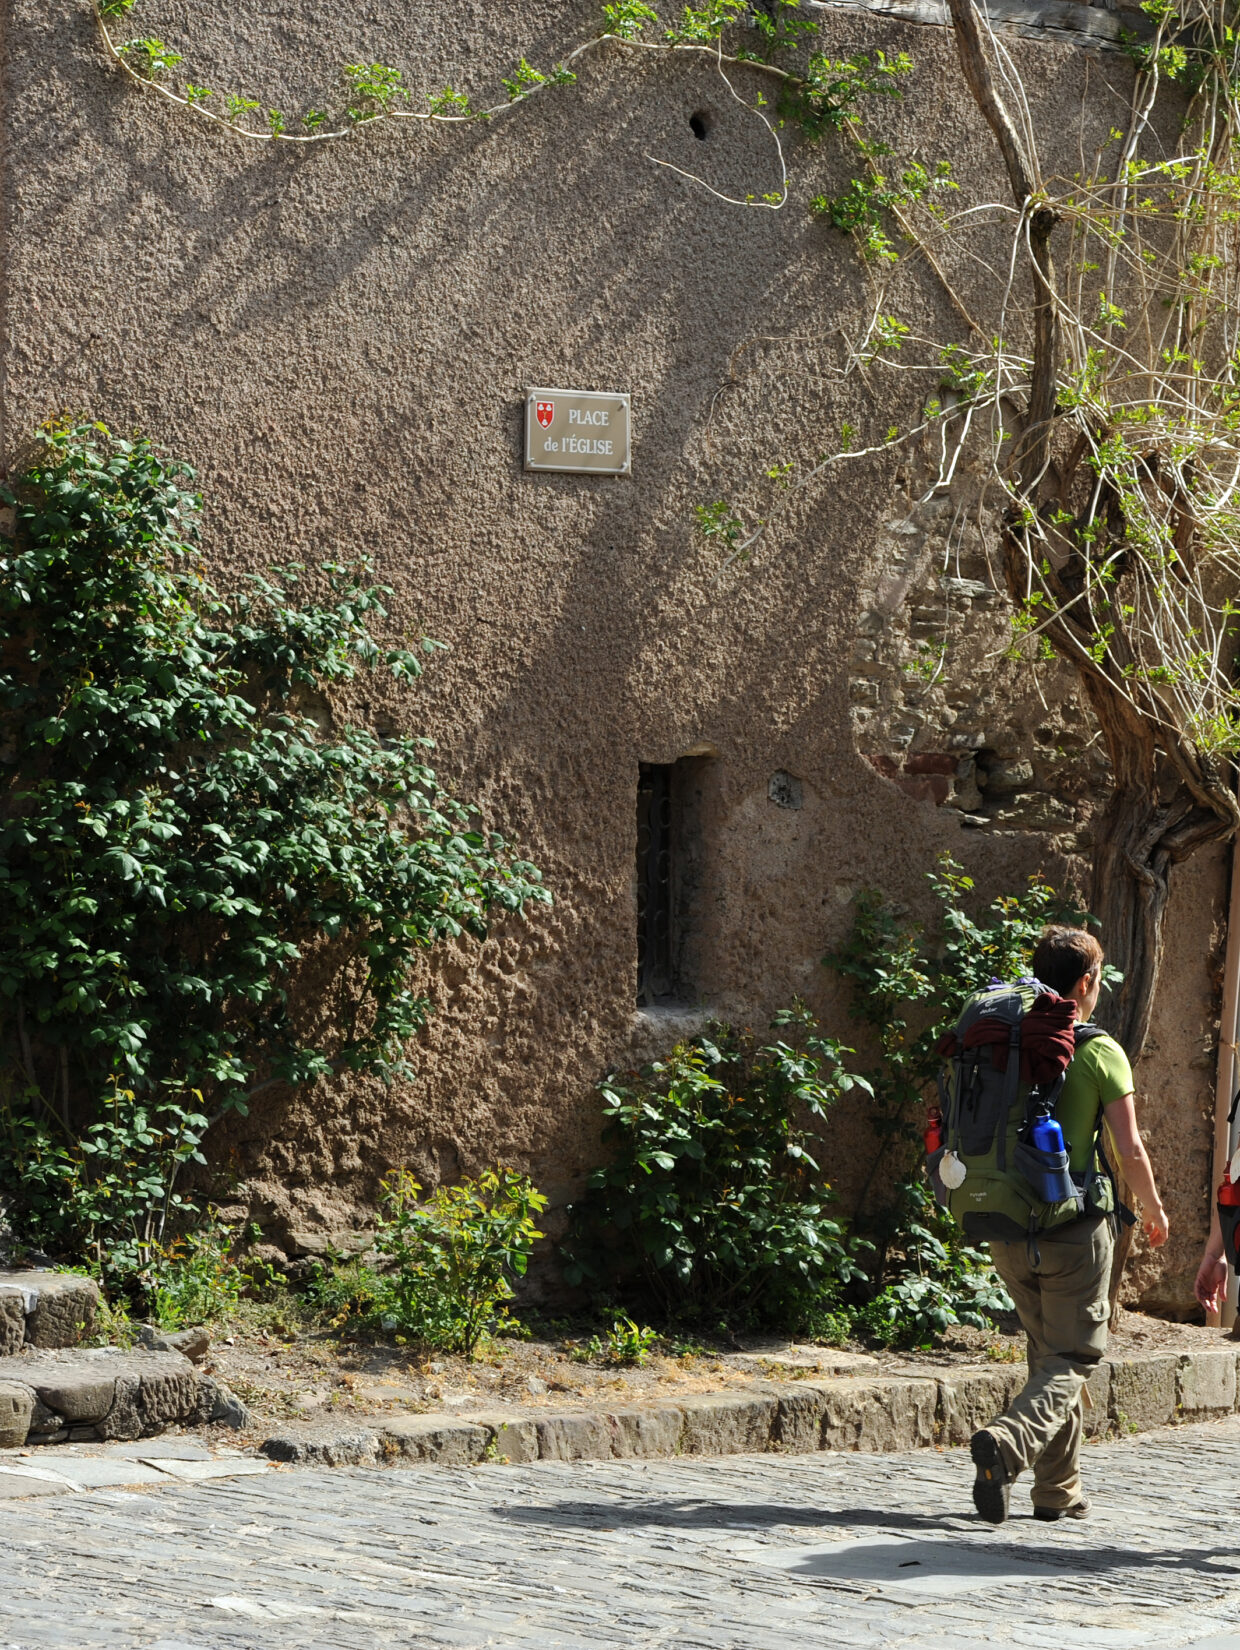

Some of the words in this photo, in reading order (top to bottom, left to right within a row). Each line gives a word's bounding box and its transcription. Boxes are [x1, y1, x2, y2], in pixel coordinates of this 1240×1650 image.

[568, 409, 609, 426] PLACE
[544, 437, 558, 452] de
[562, 434, 613, 455] l'ÉGLISE
